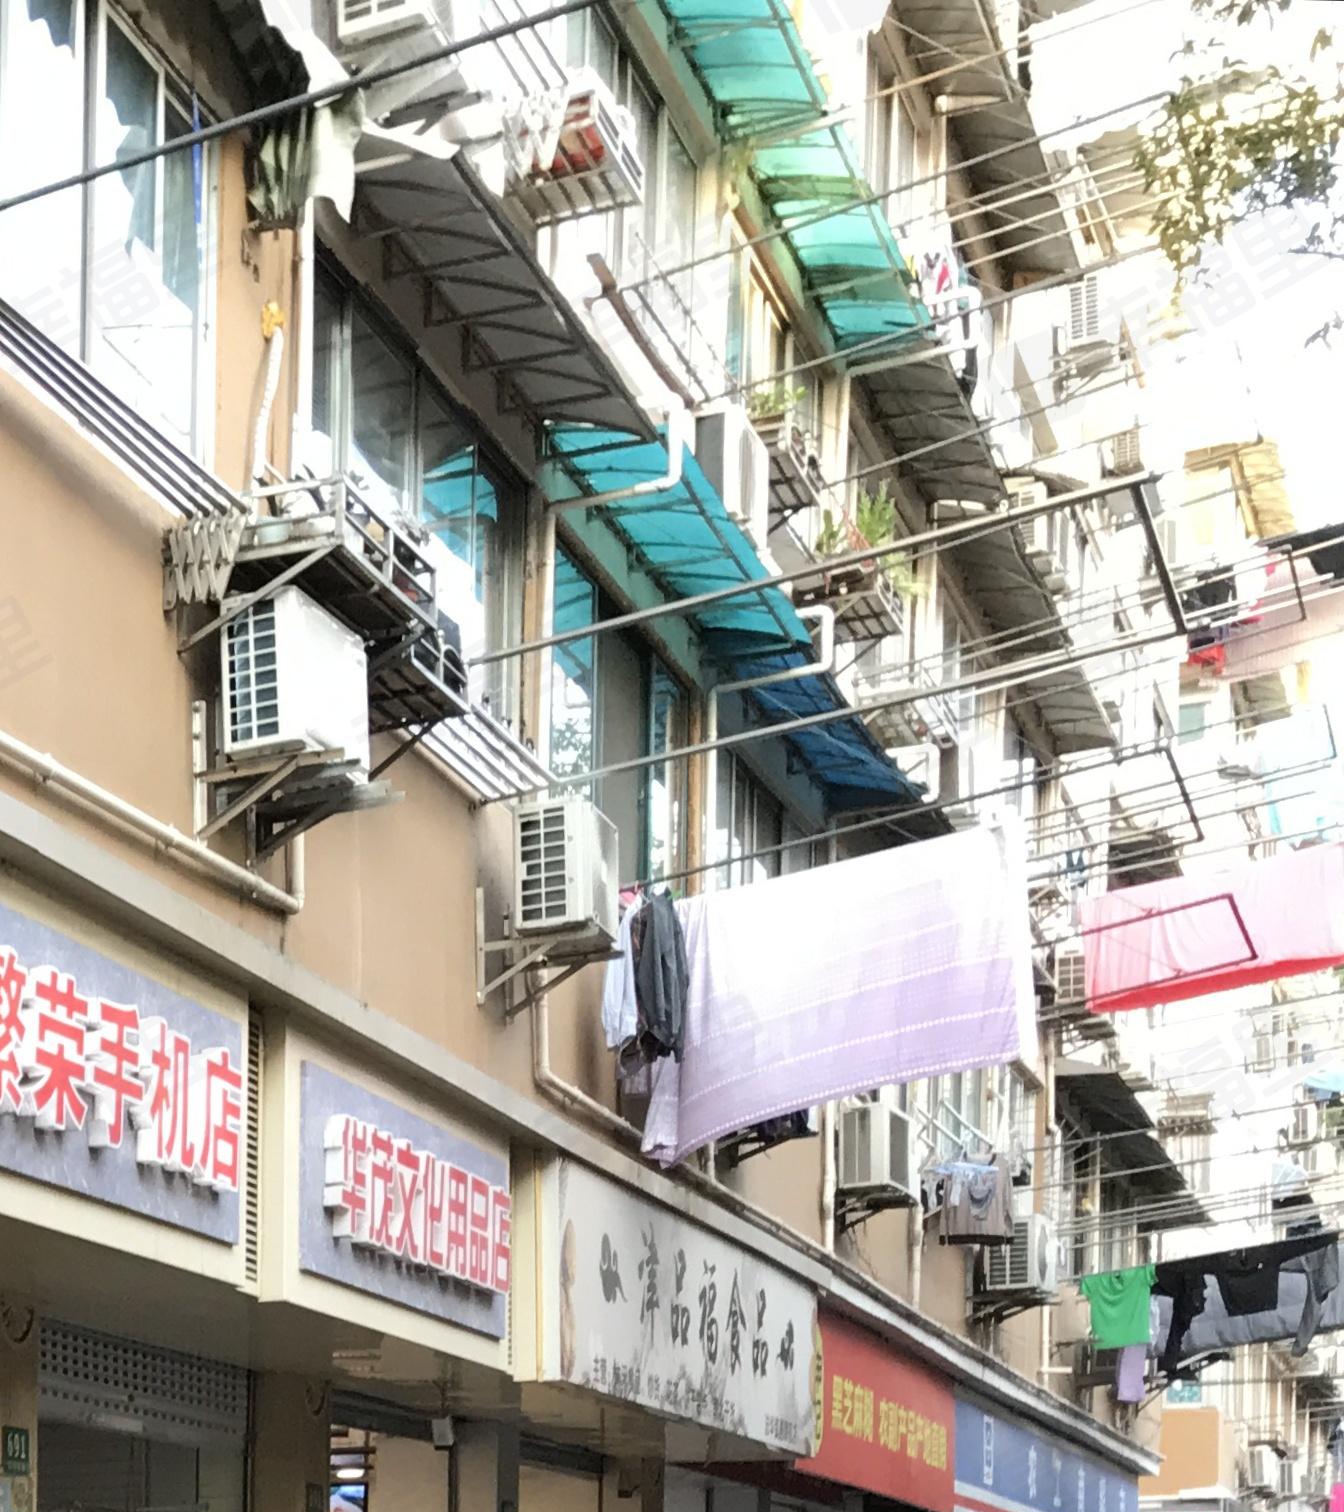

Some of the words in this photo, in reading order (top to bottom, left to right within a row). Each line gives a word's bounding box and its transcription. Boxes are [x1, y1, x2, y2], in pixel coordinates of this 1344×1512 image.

[330, 1114, 512, 1296] 华茂文化用品店
